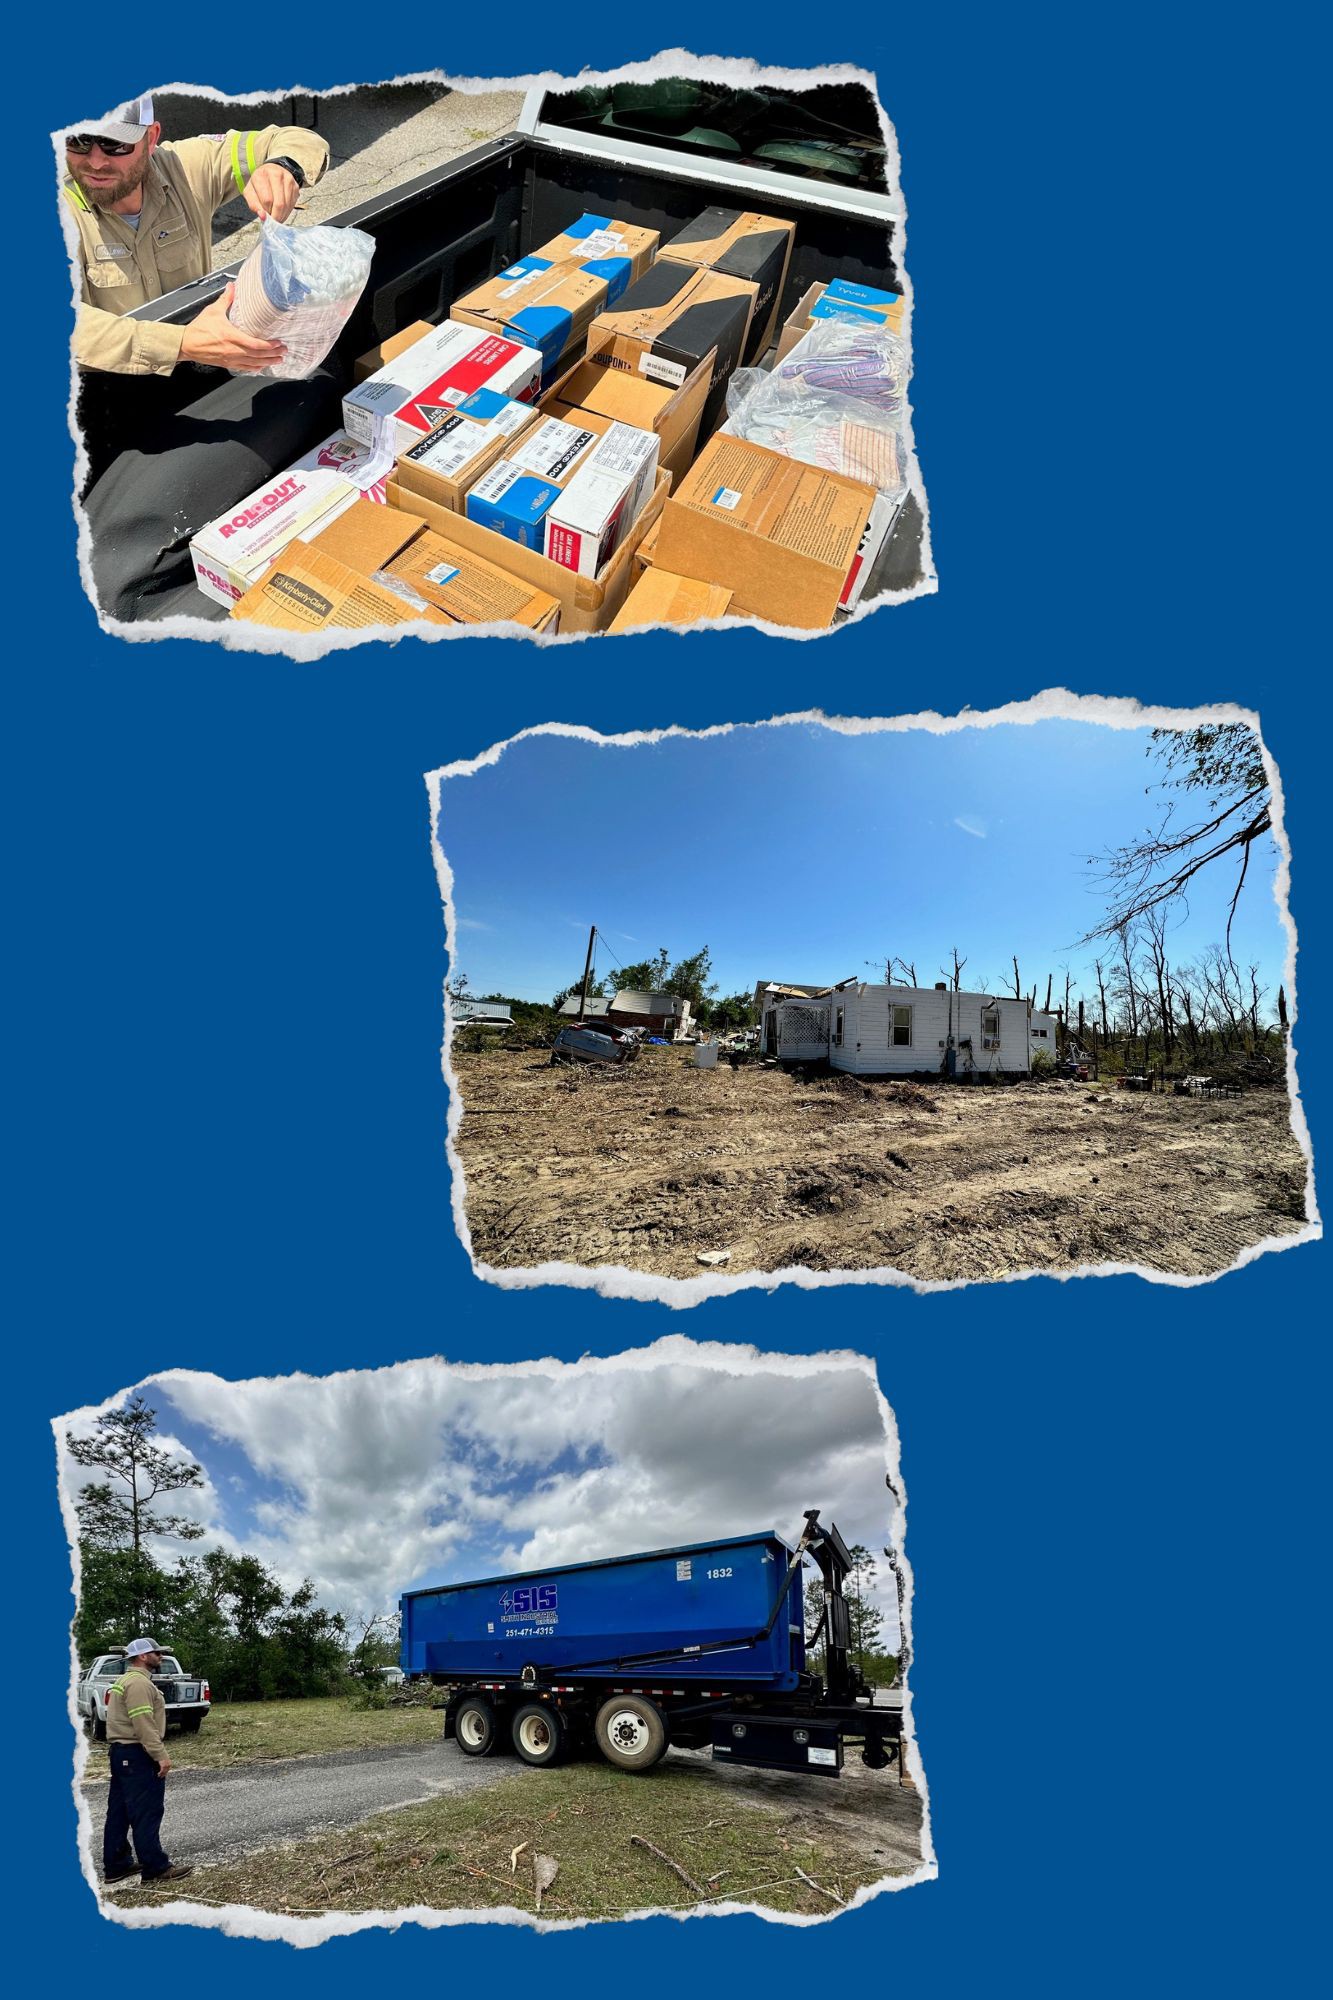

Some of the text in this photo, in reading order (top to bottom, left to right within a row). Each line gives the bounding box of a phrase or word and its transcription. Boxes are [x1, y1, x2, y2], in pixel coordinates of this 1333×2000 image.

[838, 286, 868, 298] Tyvek
[596, 353, 628, 370] DUPONT
[446, 417, 460, 430] 400
[549, 463, 563, 477] 400
[707, 1567, 732, 1579] 1832
[513, 1584, 558, 1613] SIS
[506, 1626, 553, 1637] 251-471-4315
